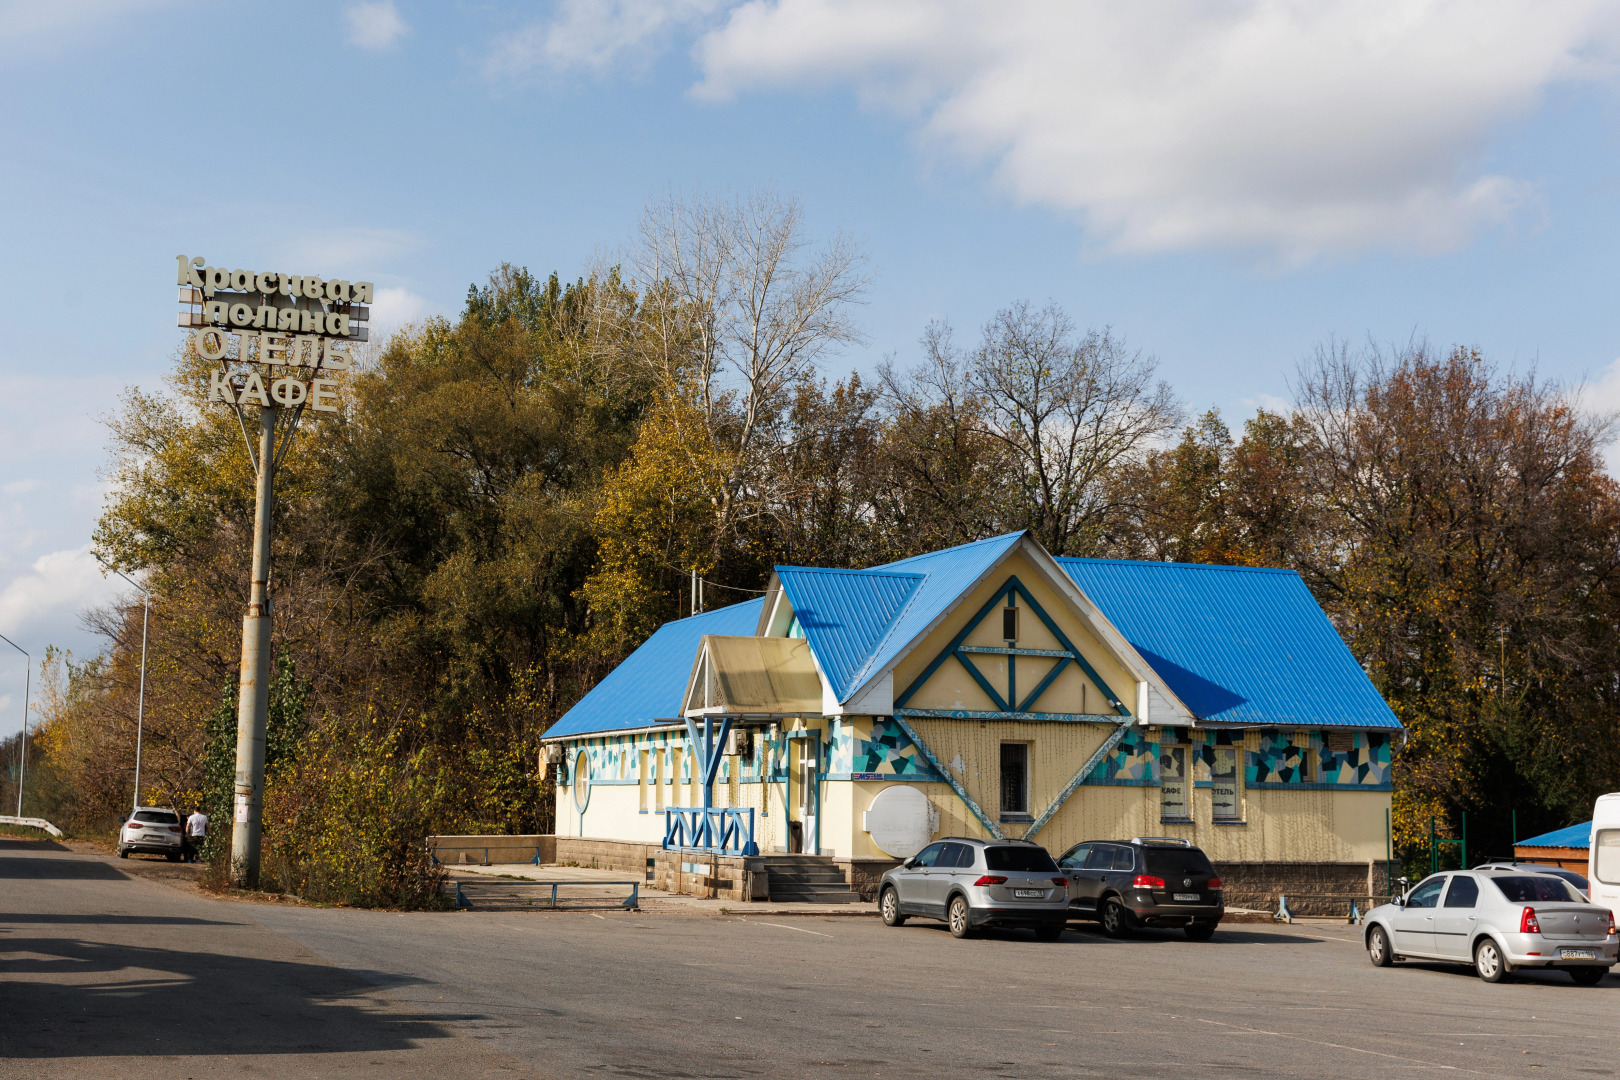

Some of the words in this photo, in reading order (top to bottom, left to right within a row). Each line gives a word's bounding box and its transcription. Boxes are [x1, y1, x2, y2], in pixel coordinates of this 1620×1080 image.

[176, 254, 374, 304] Красивая
[204, 300, 351, 336] поляна
[195, 326, 350, 370] ОТЕЛЬ
[210, 369, 338, 412] КАФЕ
[1161, 787, 1181, 795] КАФЕ
[1212, 788, 1234, 796] ОТЕЛЬ
